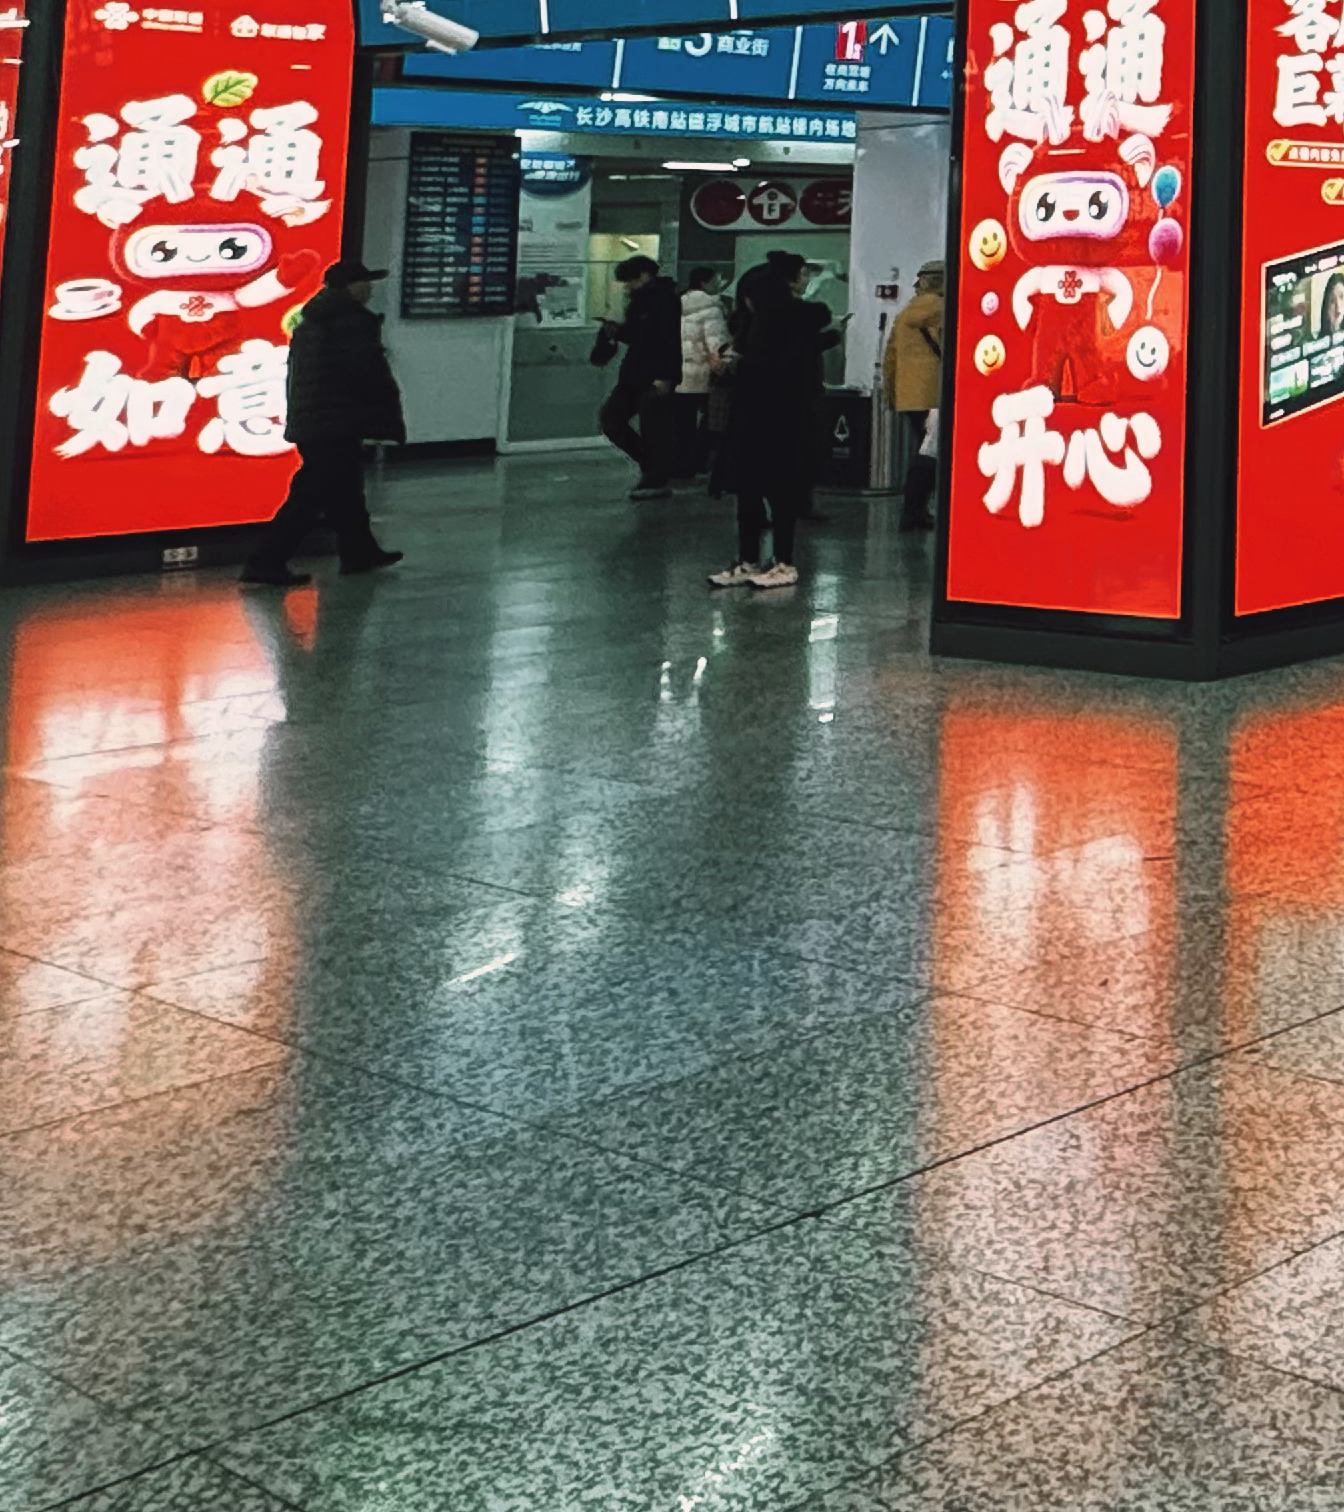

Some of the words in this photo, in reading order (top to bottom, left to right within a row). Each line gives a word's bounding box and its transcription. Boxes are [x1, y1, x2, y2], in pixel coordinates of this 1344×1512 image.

[73, 93, 333, 229] 通通
[49, 338, 298, 460] 如意
[977, 385, 1162, 528] 开心
